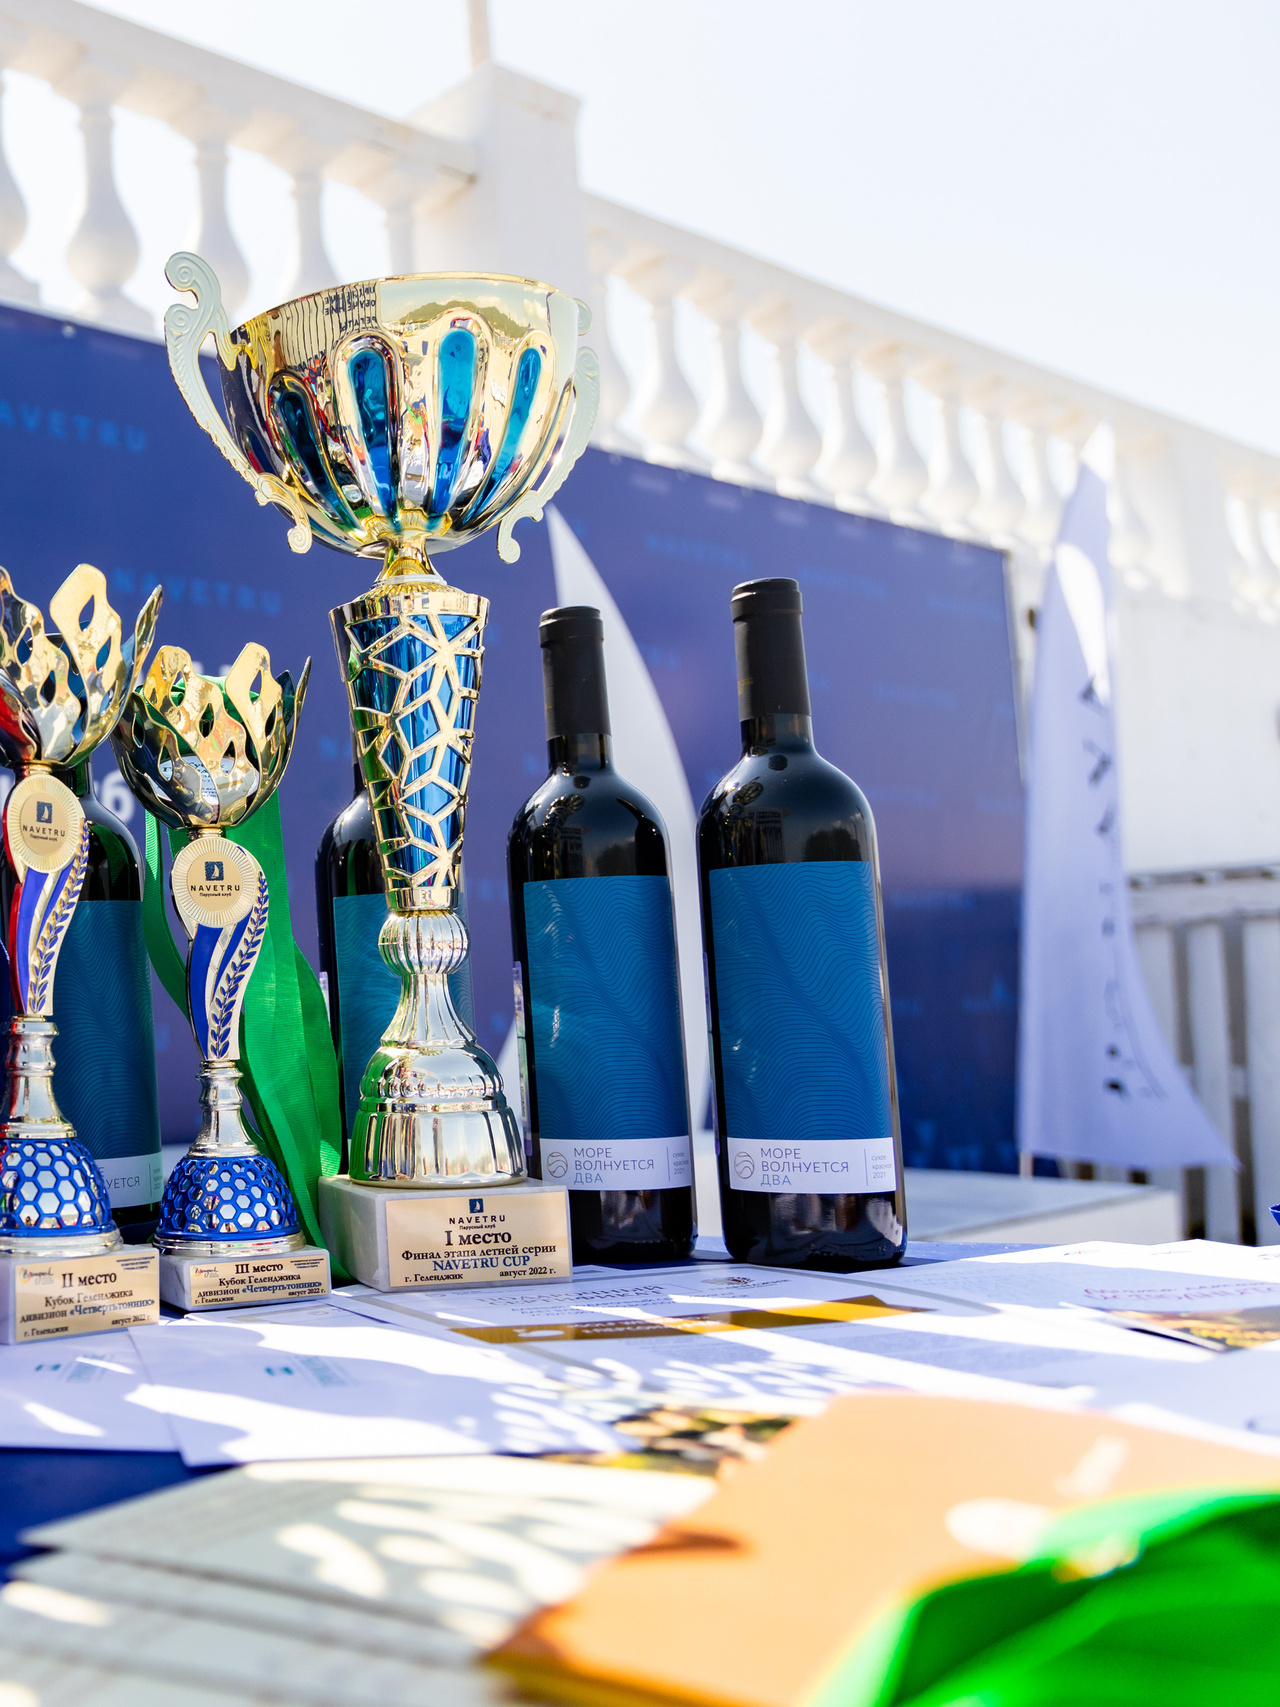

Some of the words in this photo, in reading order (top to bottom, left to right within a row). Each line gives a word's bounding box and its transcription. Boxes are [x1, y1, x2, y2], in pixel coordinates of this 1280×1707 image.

[22, 824, 66, 837] NAVETRU
[574, 1147, 613, 1158] МОРЕ
[760, 1148, 802, 1160] МОРЕ
[575, 1159, 655, 1171] ВОЛНУЕТСЯ
[761, 1161, 849, 1173] ВОЛНУЕТСЯ
[106, 1176, 140, 1189] УЕТСЯ
[574, 1173, 604, 1185] ДВА
[760, 1174, 792, 1187] ДВА
[449, 1215, 506, 1224] NAVETRU
[445, 1230, 453, 1246] I
[458, 1231, 512, 1245] место
[402, 1250, 441, 1260] Финал
[444, 1250, 476, 1259] этапа
[479, 1245, 519, 1257] летней
[522, 1245, 557, 1257] серии
[235, 1263, 249, 1274] III
[252, 1263, 284, 1273] место
[433, 1257, 499, 1271] NAVETRU
[502, 1255, 530, 1267] CUP
[414, 1273, 463, 1282] Геленджик
[499, 1269, 527, 1278] август
[529, 1267, 548, 1276] 2022
[62, 1273, 74, 1288] II
[78, 1272, 117, 1287] место
[218, 1278, 247, 1289] Кубок
[248, 1274, 301, 1284] Геленджика
[197, 1288, 240, 1298] дивизион
[288, 1289, 307, 1297] август
[44, 1296, 74, 1309] Кубок
[77, 1290, 133, 1304] Геленджика
[201, 1296, 234, 1304] Геленджик
[20, 1310, 67, 1323] дивизион
[132, 1315, 146, 1323] 2022
